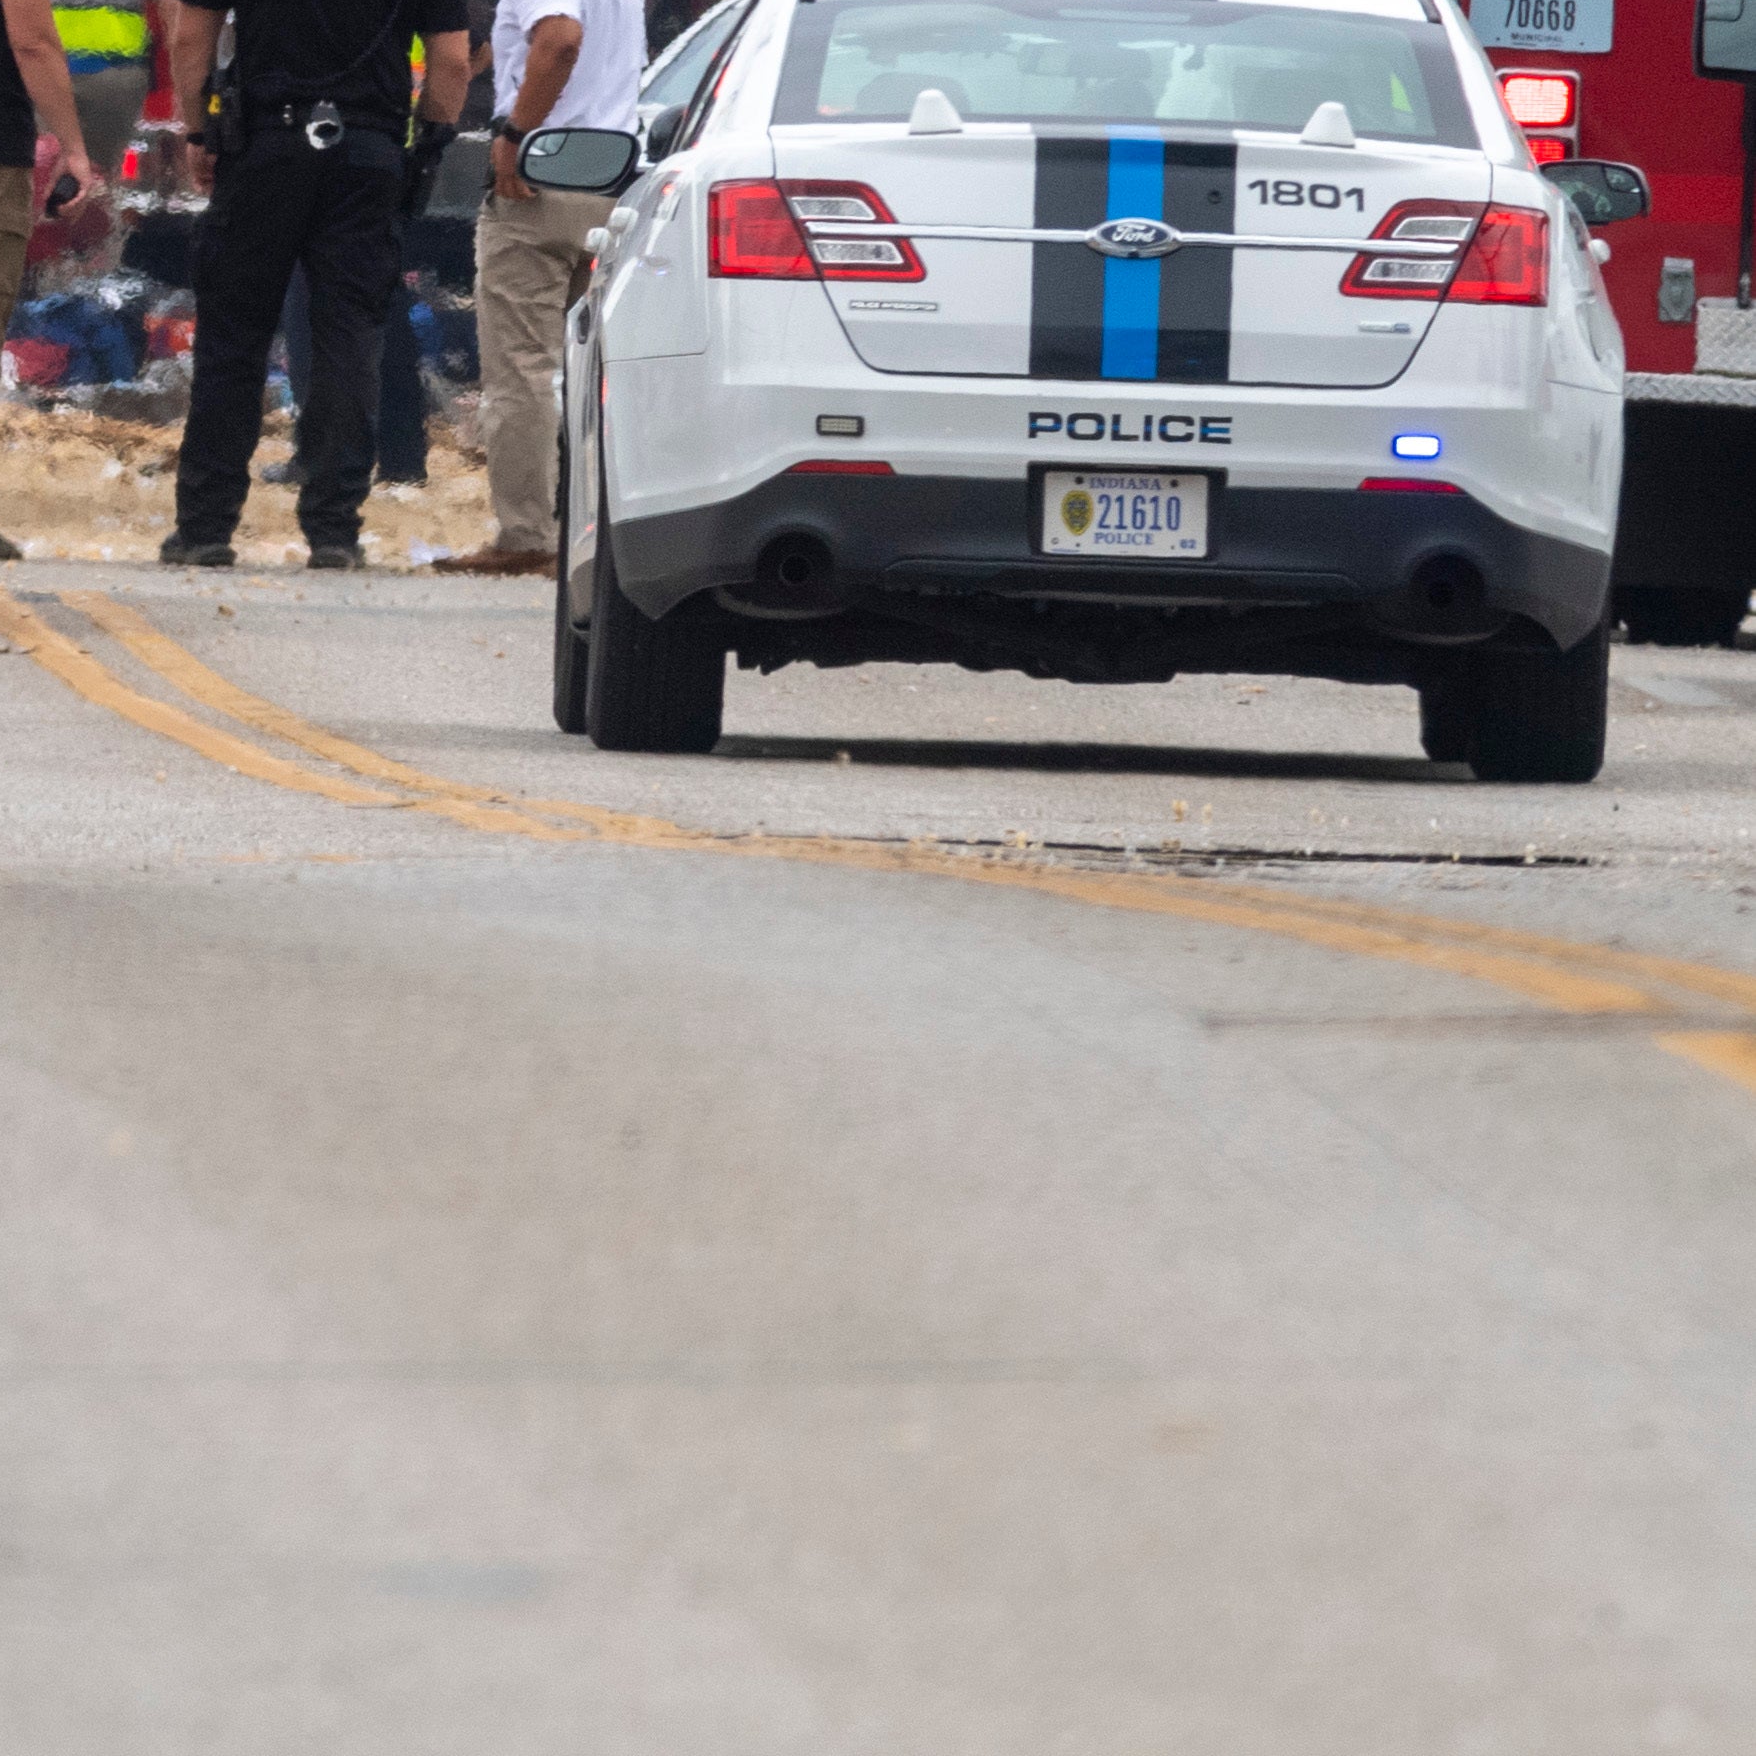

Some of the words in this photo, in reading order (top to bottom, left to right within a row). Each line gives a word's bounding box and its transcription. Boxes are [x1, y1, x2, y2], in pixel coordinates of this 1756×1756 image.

[1247, 179, 1364, 213] 1801
[1111, 224, 1157, 243] Ford
[1027, 411, 1233, 445] POLICE
[1089, 476, 1163, 491] INDIANA
[1096, 494, 1182, 532] 21610
[1093, 533, 1155, 546] POLICE
